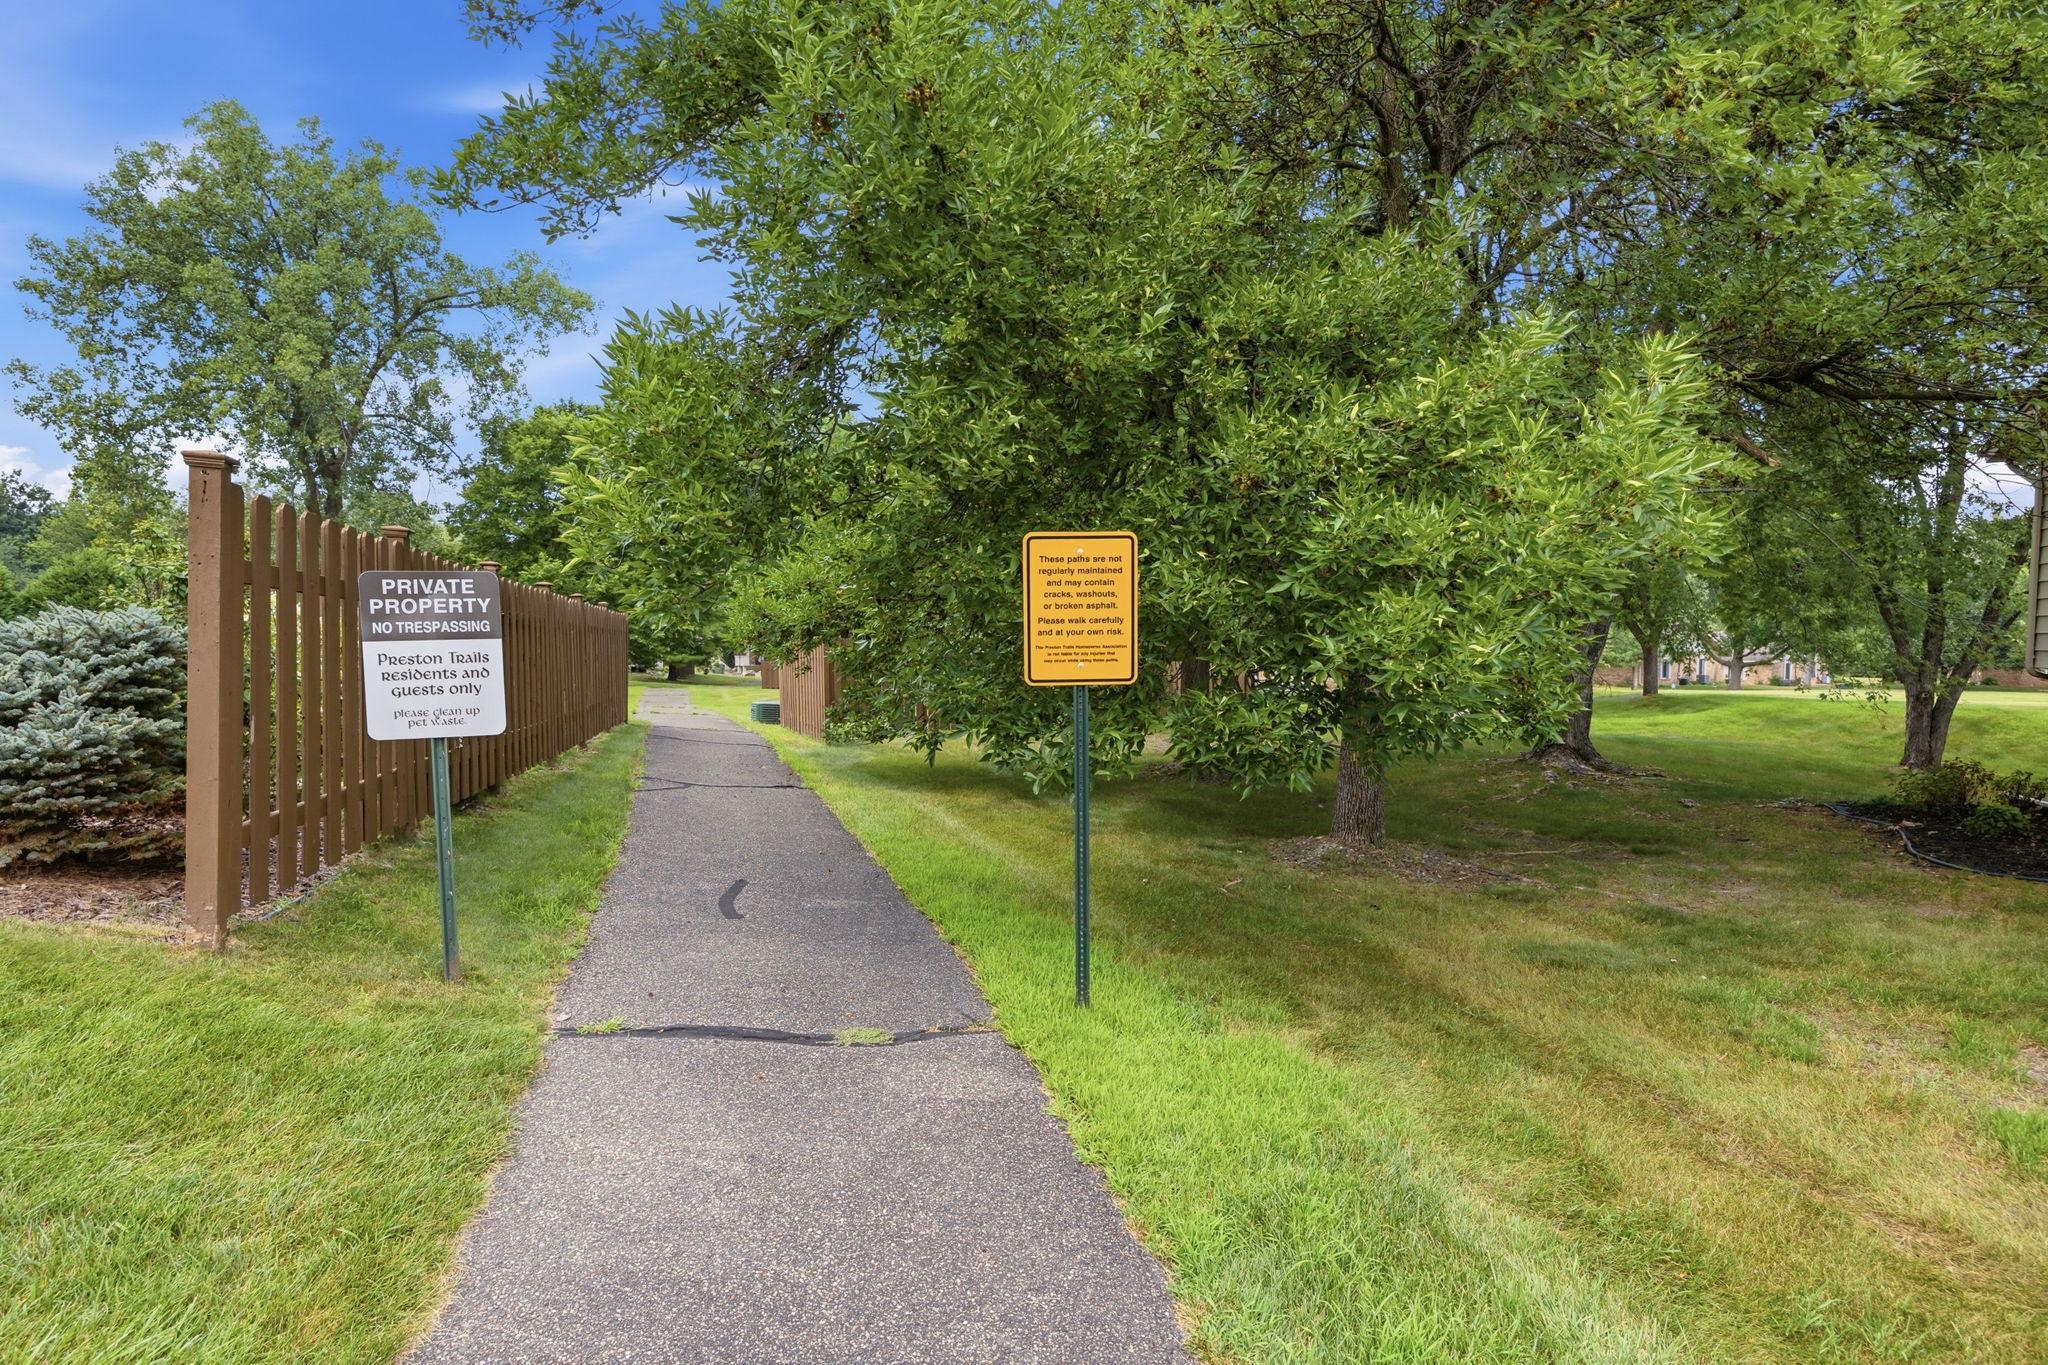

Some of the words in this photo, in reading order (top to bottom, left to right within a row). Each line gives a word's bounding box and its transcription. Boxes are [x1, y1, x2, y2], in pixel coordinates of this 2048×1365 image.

[1067, 555, 1090, 564] paths
[1038, 567, 1074, 576] regularly
[382, 579, 474, 594] PRIVATE
[370, 598, 490, 614] PROPERTY
[1086, 602, 1118, 611] asphalt.
[1089, 616, 1124, 625] carefully
[372, 622, 392, 634] NO
[396, 620, 490, 633] TRESPASSING
[377, 653, 442, 666] Preston
[448, 651, 489, 664] Trails
[462, 667, 490, 679] and
[449, 683, 482, 695] only
[394, 710, 429, 720] please
[466, 708, 480, 716] up
[408, 718, 427, 729] pet
